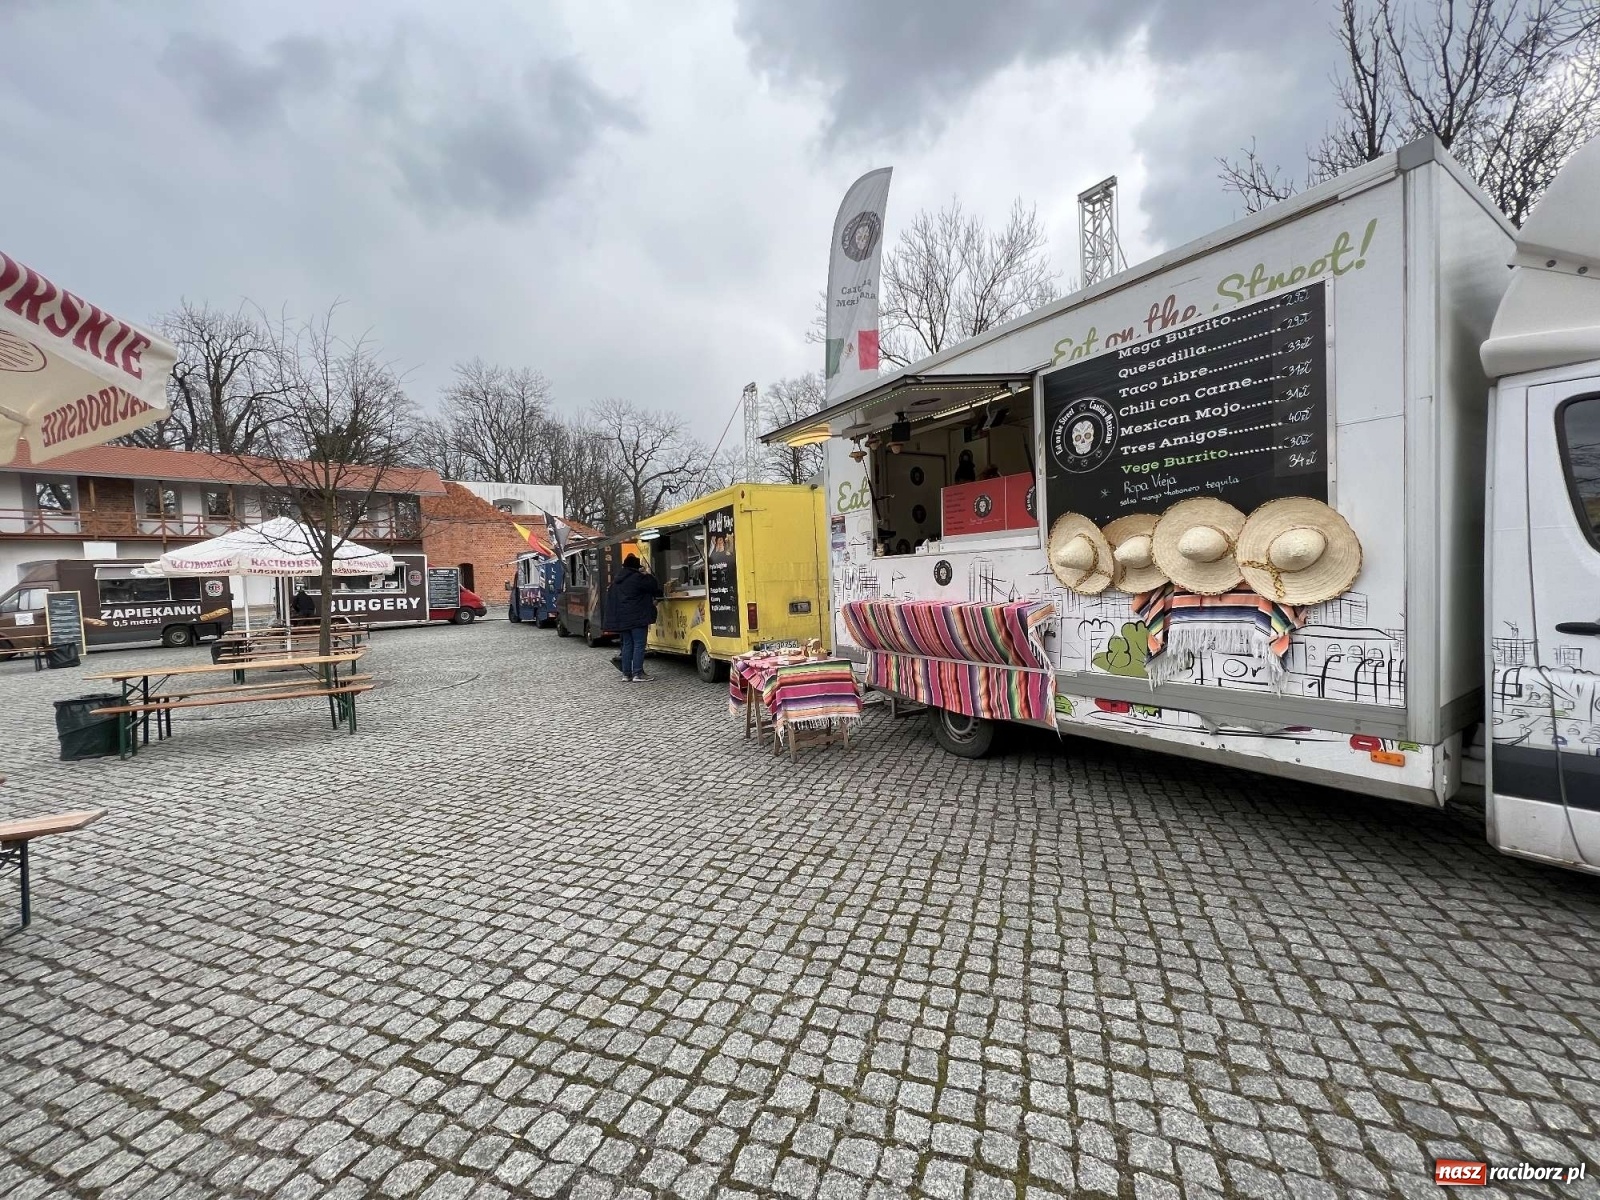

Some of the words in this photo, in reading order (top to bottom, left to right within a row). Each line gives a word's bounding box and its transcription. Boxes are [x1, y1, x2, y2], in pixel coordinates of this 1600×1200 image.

[1051, 327, 1099, 367] Eat
[1213, 218, 1377, 311] Street!
[1118, 337, 1161, 360] Mega
[1165, 315, 1232, 344] Burrito
[1118, 344, 1207, 378] Quesadilla
[1118, 381, 1158, 398] Taco
[1162, 366, 1208, 387] Libre
[1119, 399, 1156, 417] Chili
[1159, 393, 1191, 407] con
[1195, 377, 1252, 399] Carne
[1120, 413, 1191, 437] Mexican
[1195, 402, 1241, 421] Mojo
[1120, 441, 1156, 455] Tres
[1159, 427, 1229, 448] Amigos
[1121, 460, 1159, 474] Vege
[1164, 449, 1229, 467] Burrito
[837, 476, 871, 512] Eat
[1151, 473, 1178, 492] Vieja
[1205, 475, 1240, 493] tequila
[251, 557, 319, 567] RACIBORSK
[100, 605, 201, 619] ZAPIEKANKI
[130, 618, 162, 626] metra!
